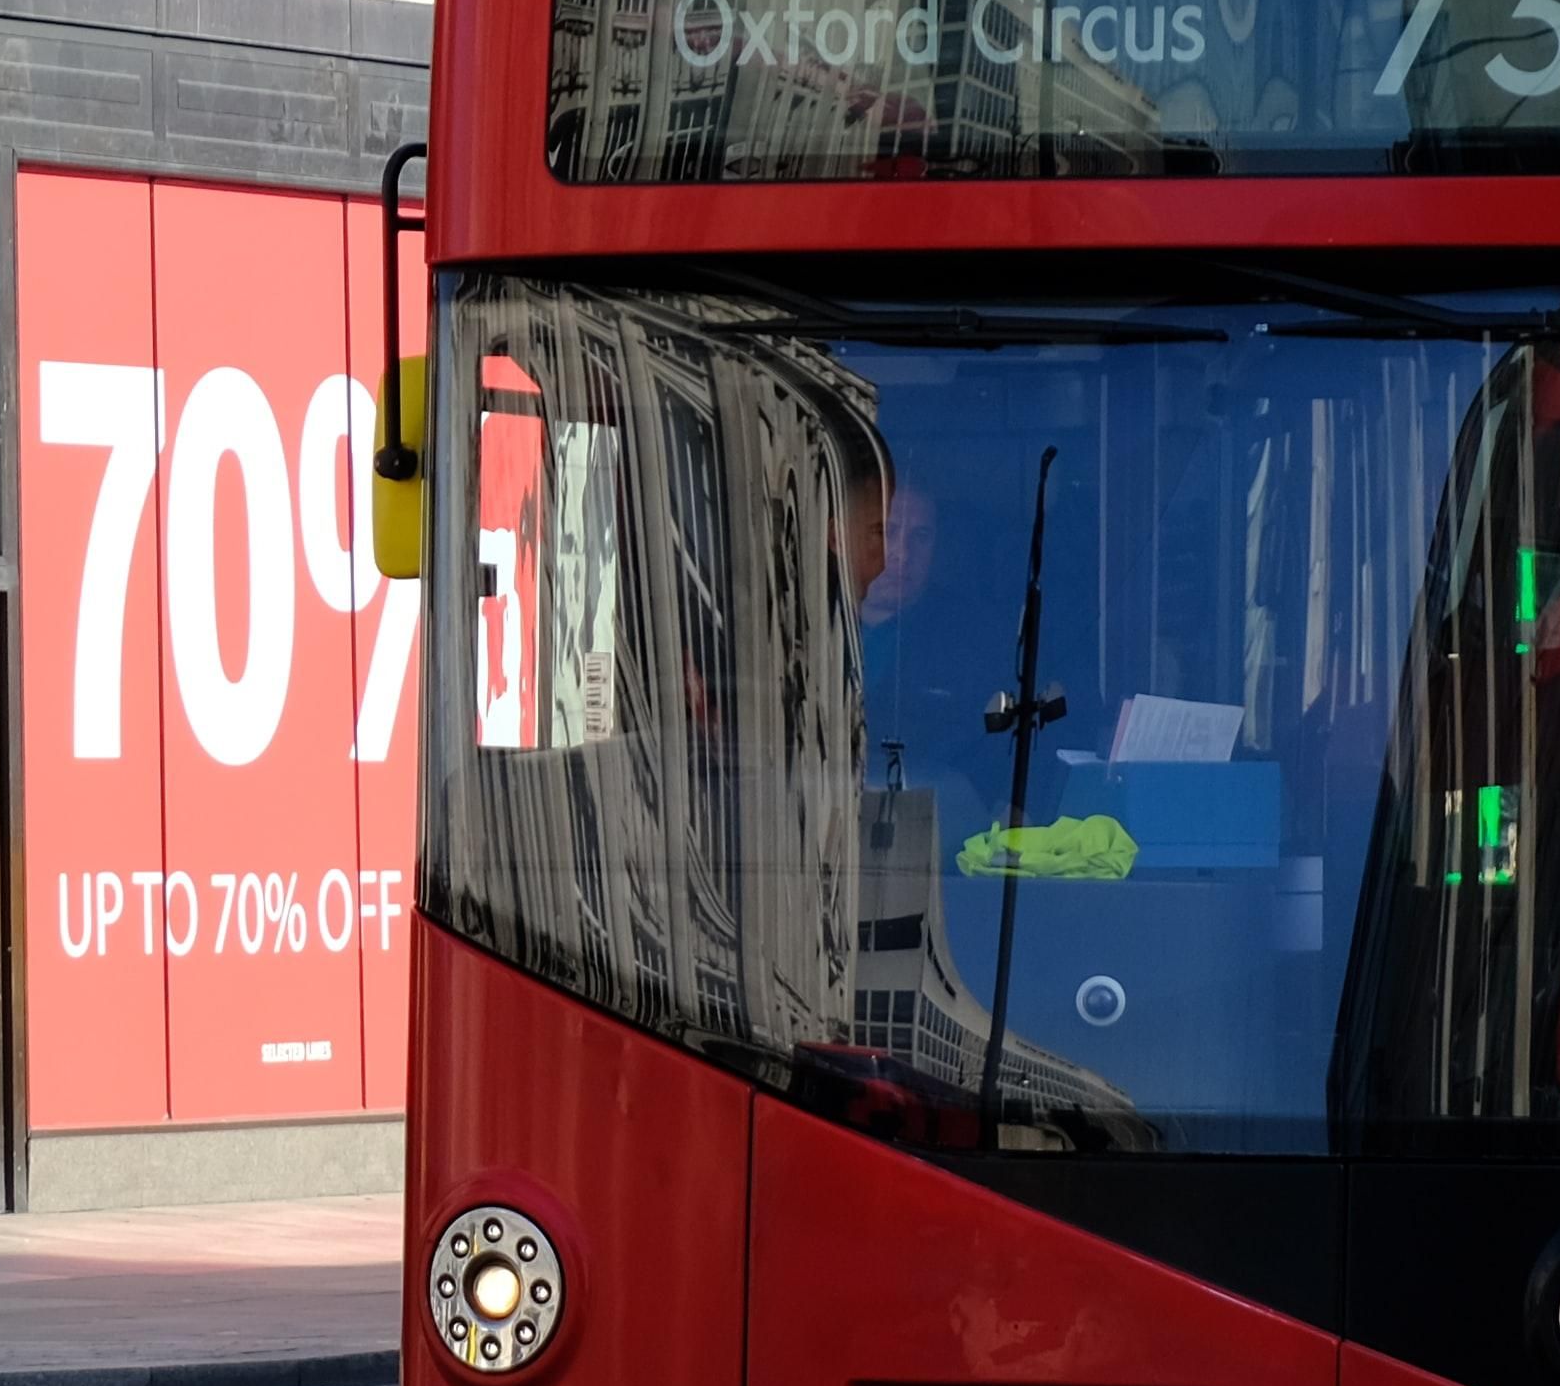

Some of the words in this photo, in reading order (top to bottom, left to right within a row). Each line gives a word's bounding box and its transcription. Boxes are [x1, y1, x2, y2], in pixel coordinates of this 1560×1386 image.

[59, 871, 123, 959] UP
[124, 870, 199, 957] TO
[210, 871, 307, 955] 70%
[317, 867, 403, 953] OFF
